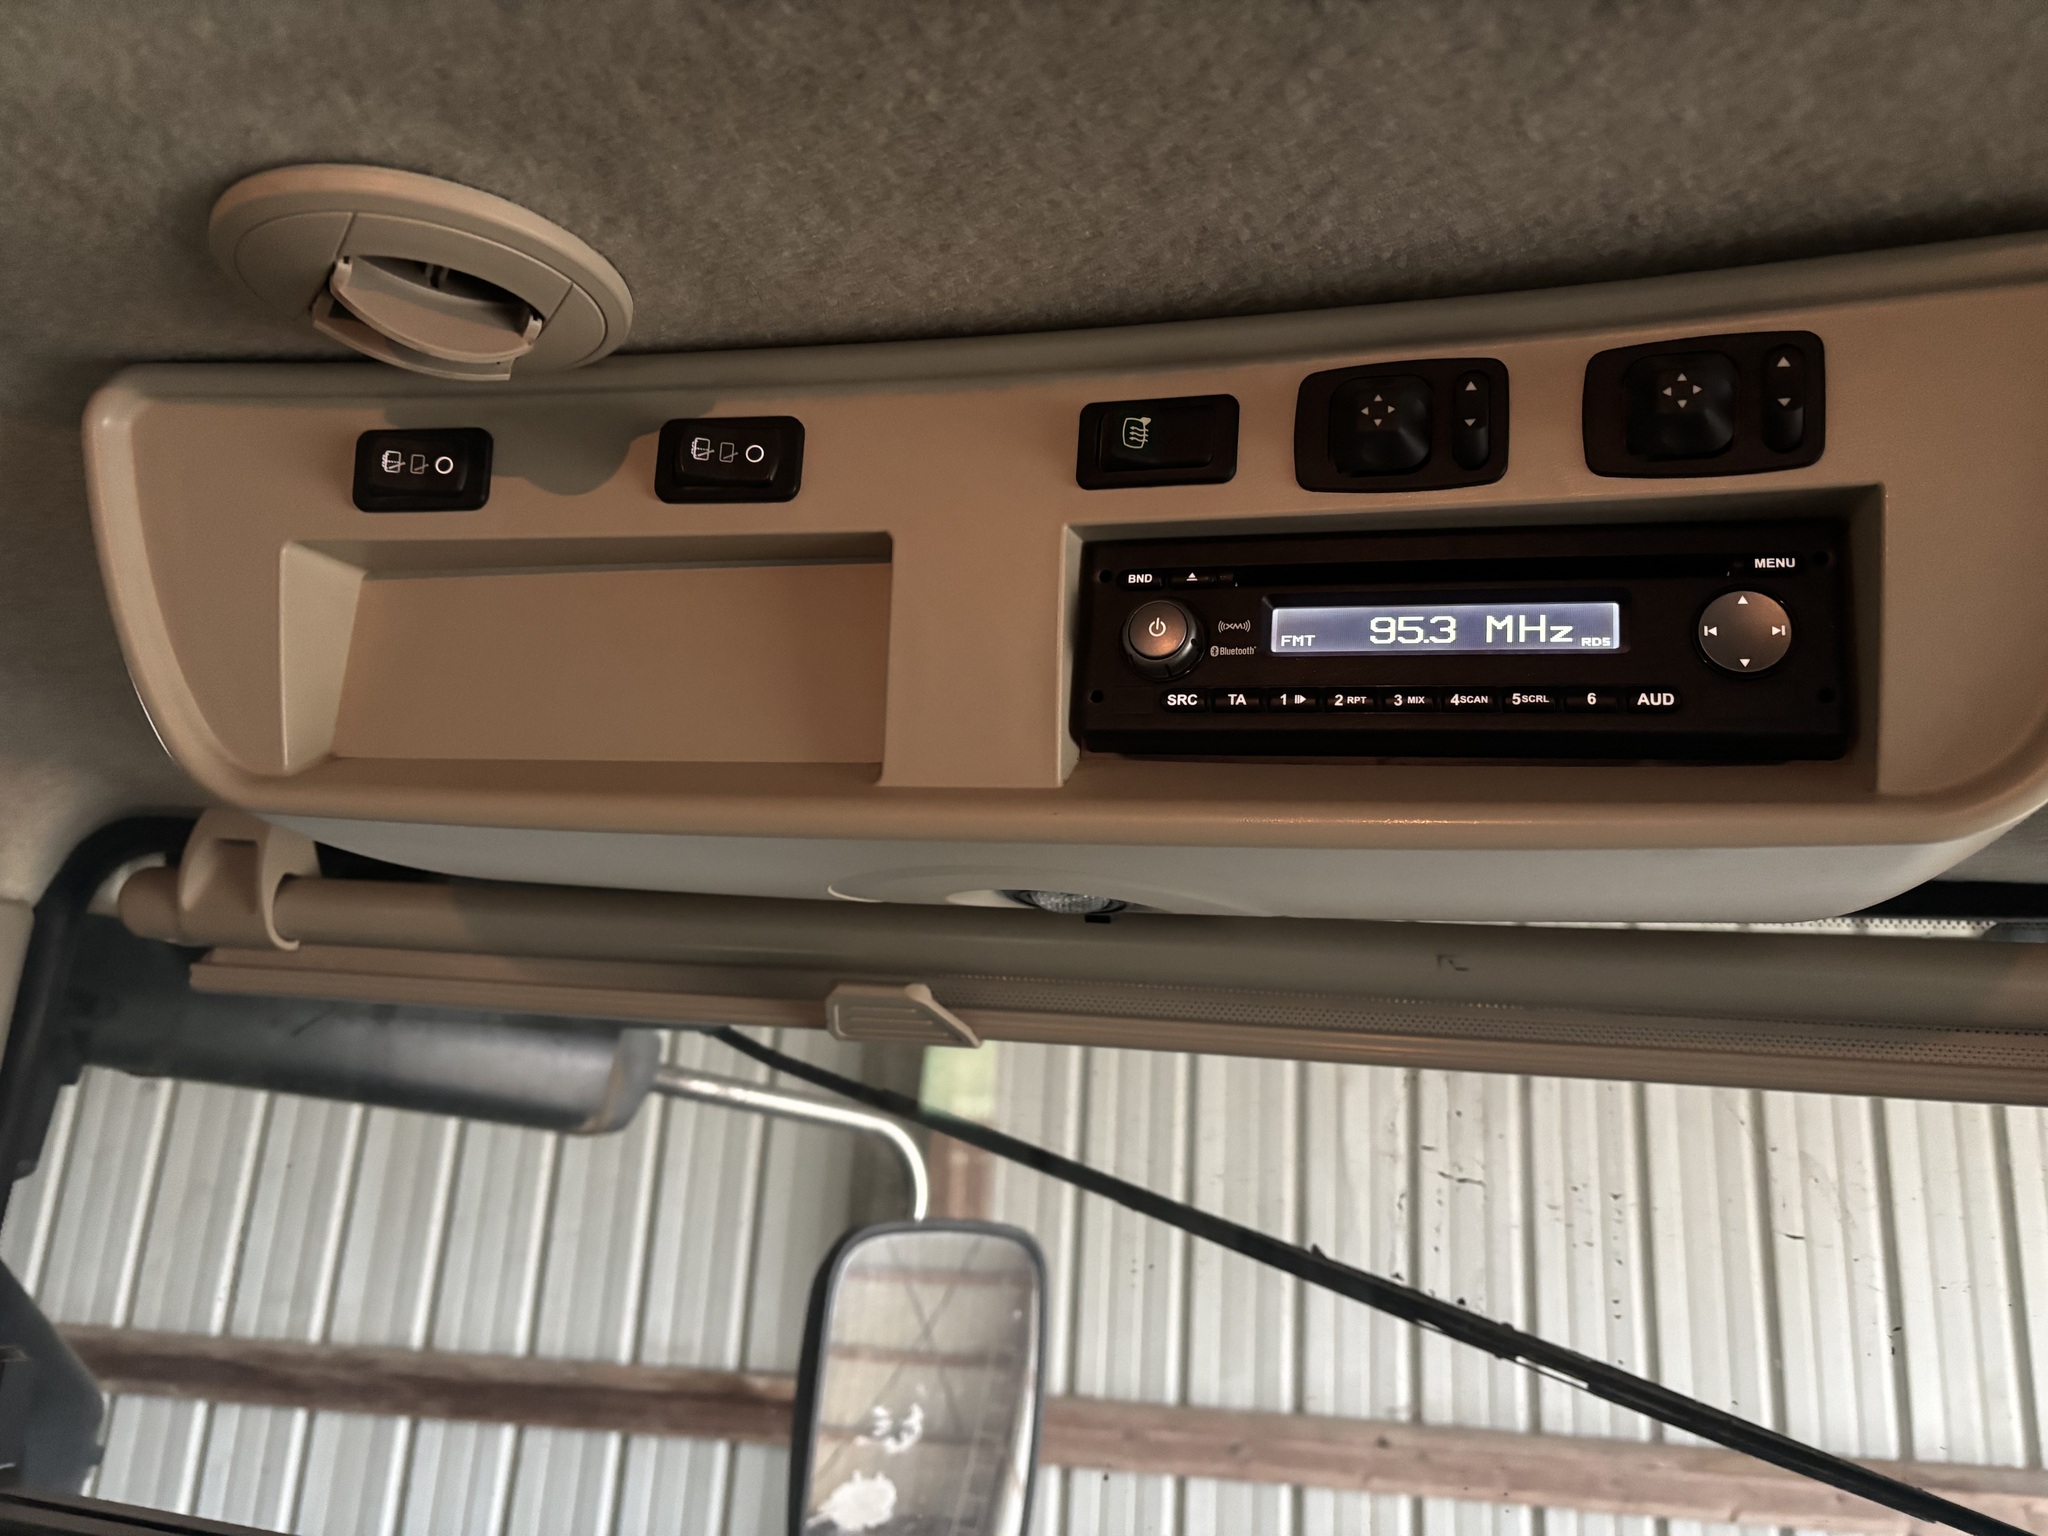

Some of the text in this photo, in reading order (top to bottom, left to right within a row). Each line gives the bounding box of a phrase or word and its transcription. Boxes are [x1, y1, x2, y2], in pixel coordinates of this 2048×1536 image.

[1754, 558, 1796, 568] MENU
[1127, 573, 1153, 584] BND
[1369, 614, 1574, 644] 95.3 MHz
[1280, 634, 1316, 647] FMT
[1219, 645, 1255, 656] Bluetooth
[1166, 693, 1198, 706] SRC
[1227, 693, 1247, 706] TA
[1279, 693, 1288, 706] 1
[1334, 694, 1367, 707] 2 RPT
[1393, 694, 1425, 707] 3 MIX
[1586, 692, 1597, 705] 6
[1636, 692, 1675, 706] AUD
